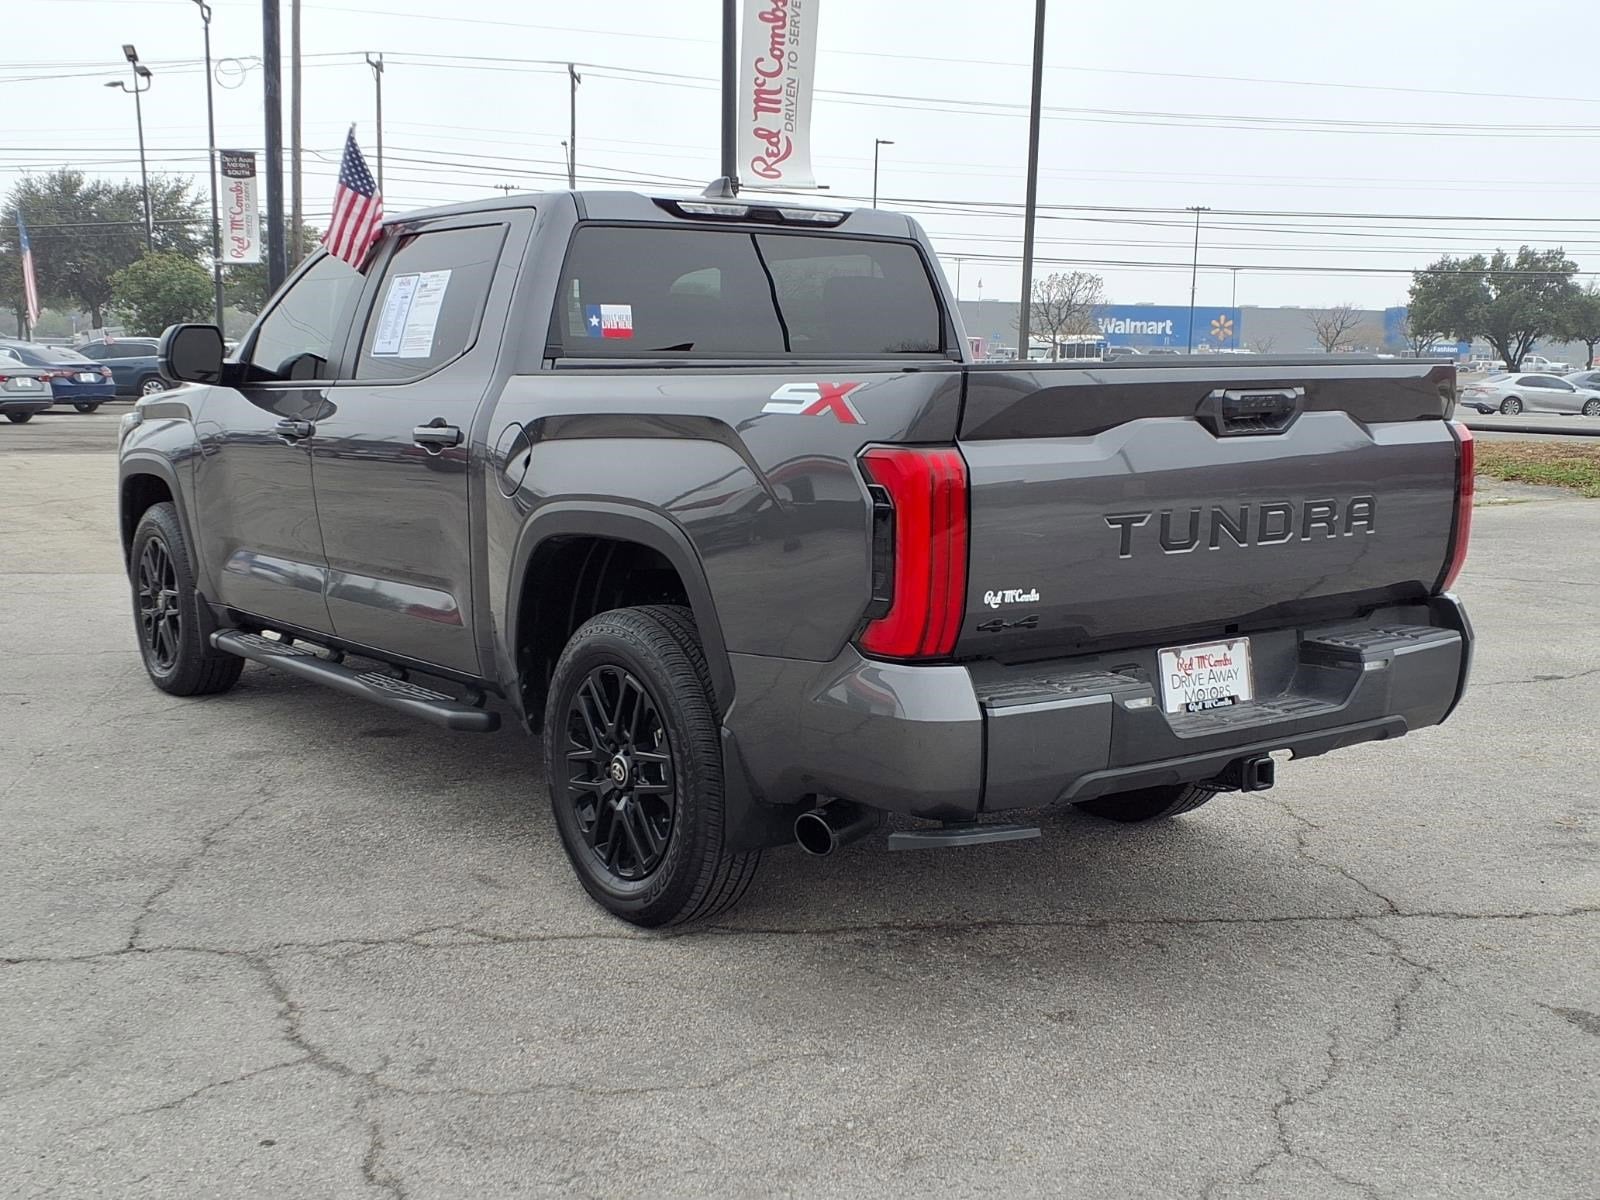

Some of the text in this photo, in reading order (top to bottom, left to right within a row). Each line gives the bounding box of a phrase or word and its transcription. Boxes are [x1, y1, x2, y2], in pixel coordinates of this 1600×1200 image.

[784, 0, 802, 133] DRIVEN TO SERVE
[751, 127, 792, 179] Red
[230, 235, 250, 259] Red
[1098, 317, 1173, 335] Walmart
[760, 382, 870, 425] SX
[1103, 494, 1377, 559] TUNDRA
[984, 588, 1040, 609] Red McCombs
[1176, 652, 1233, 676] Red McCombs
[1171, 667, 1239, 690] DRIVE AWAY
[1184, 685, 1232, 703] MOTORS
[1188, 700, 1203, 712] Red
